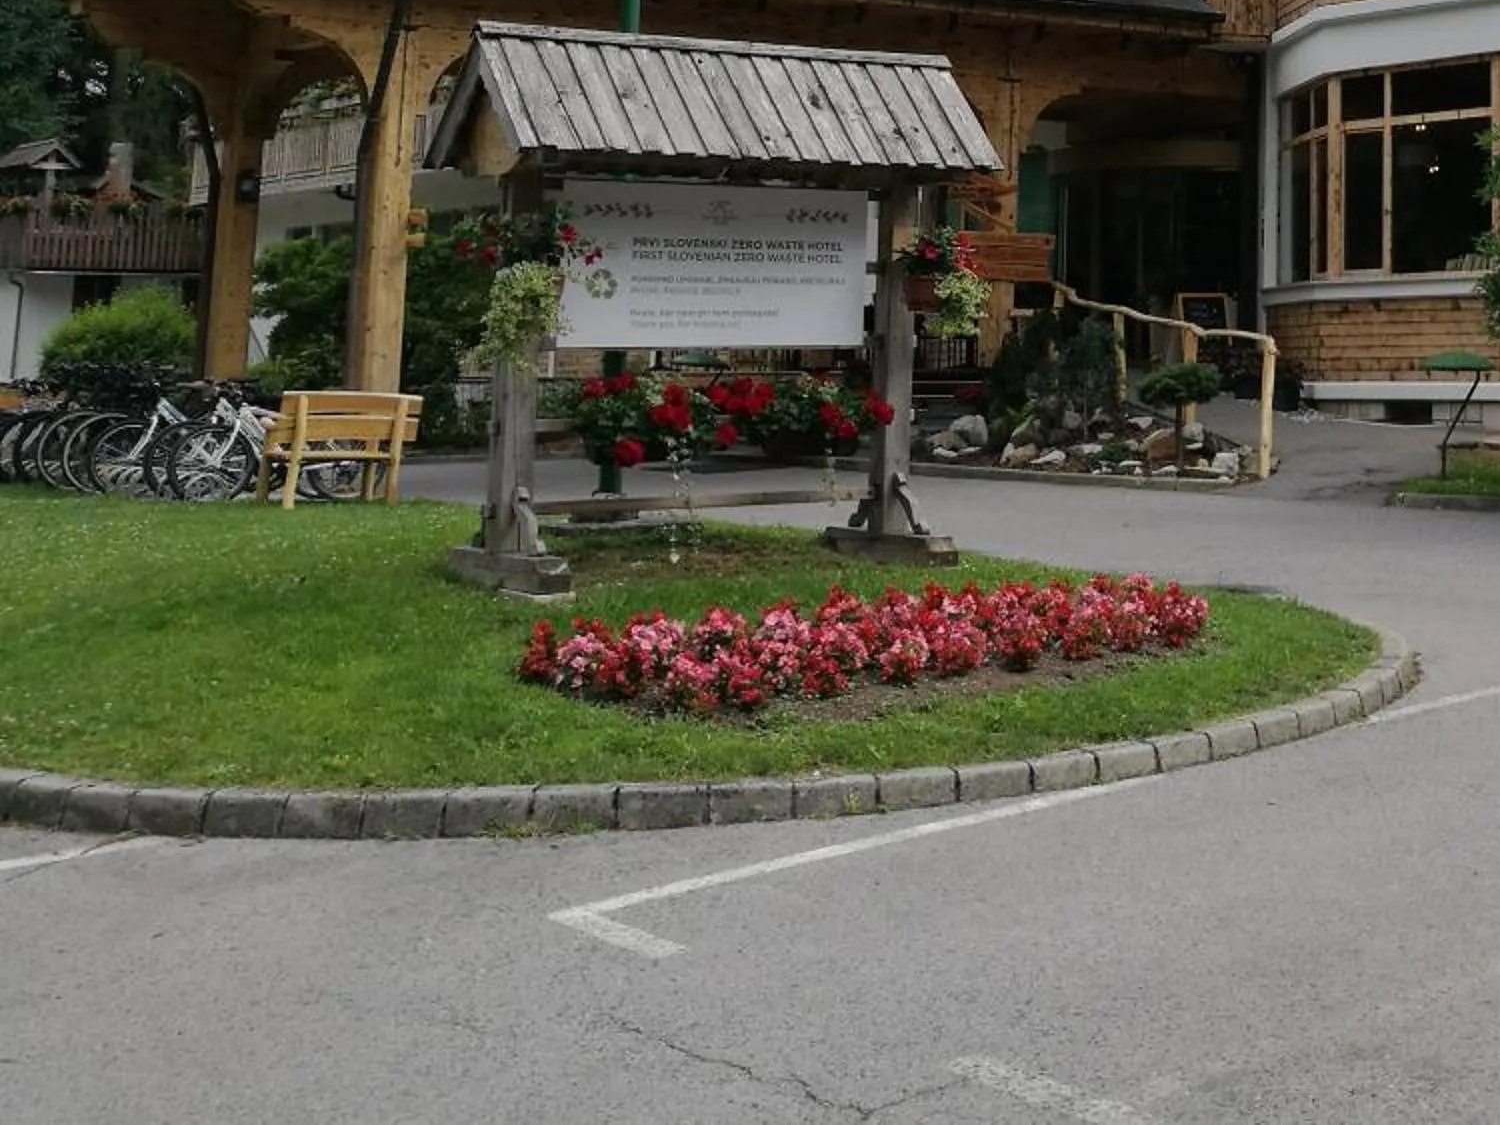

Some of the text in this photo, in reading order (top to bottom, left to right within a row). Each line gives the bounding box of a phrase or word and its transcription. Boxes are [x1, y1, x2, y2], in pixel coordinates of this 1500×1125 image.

[663, 238, 727, 249] SLOVENSKI
[731, 239, 762, 250] ZERO
[767, 240, 805, 251] WASTE
[808, 241, 843, 252] HOTEL
[632, 250, 842, 264] FIRST SLOVENIAN ZERO WASTE HOTEL
